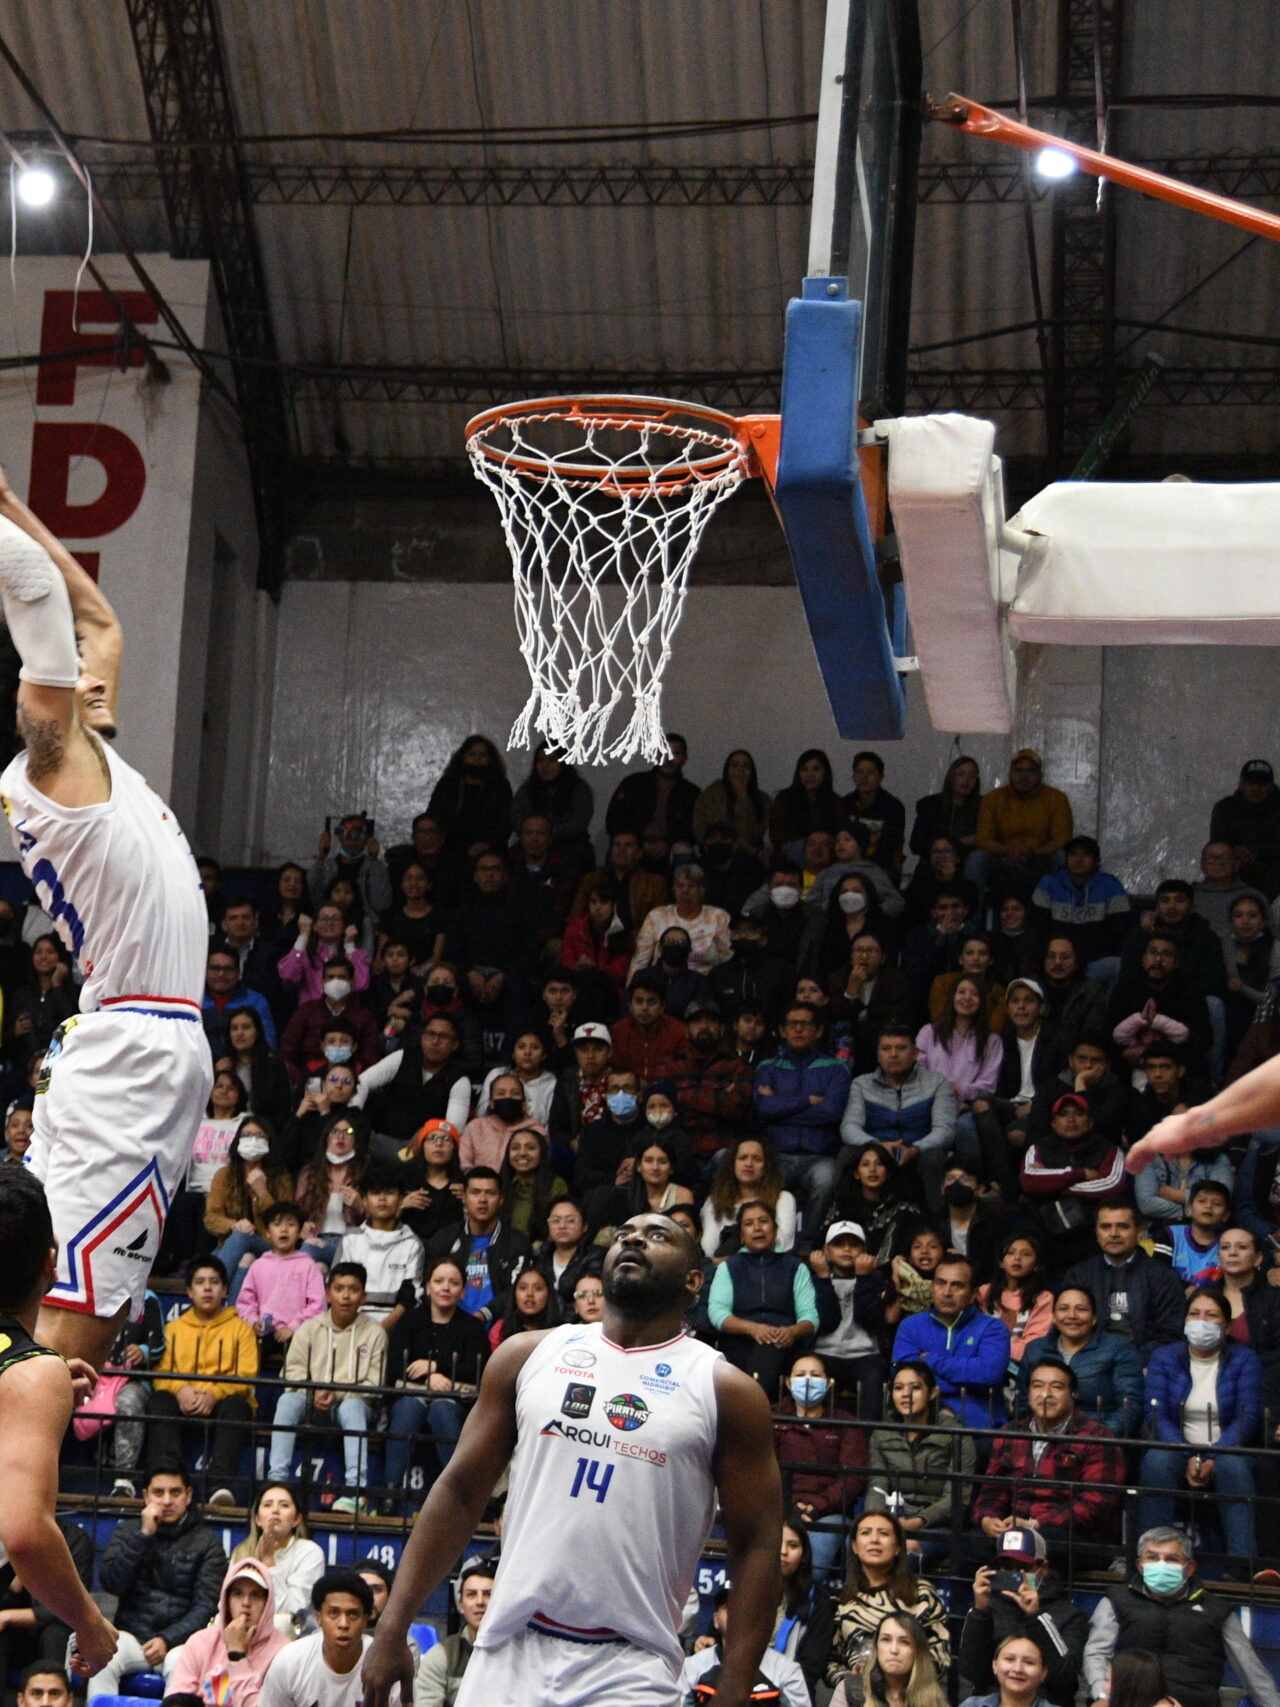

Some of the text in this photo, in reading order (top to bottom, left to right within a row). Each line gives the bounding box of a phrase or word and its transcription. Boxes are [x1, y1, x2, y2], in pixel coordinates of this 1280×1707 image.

[554, 1366, 595, 1379] TOYOTA
[605, 1402, 650, 1421] PIRATAS
[613, 1440, 667, 1464] TECHOS
[570, 1457, 615, 1503] 14
